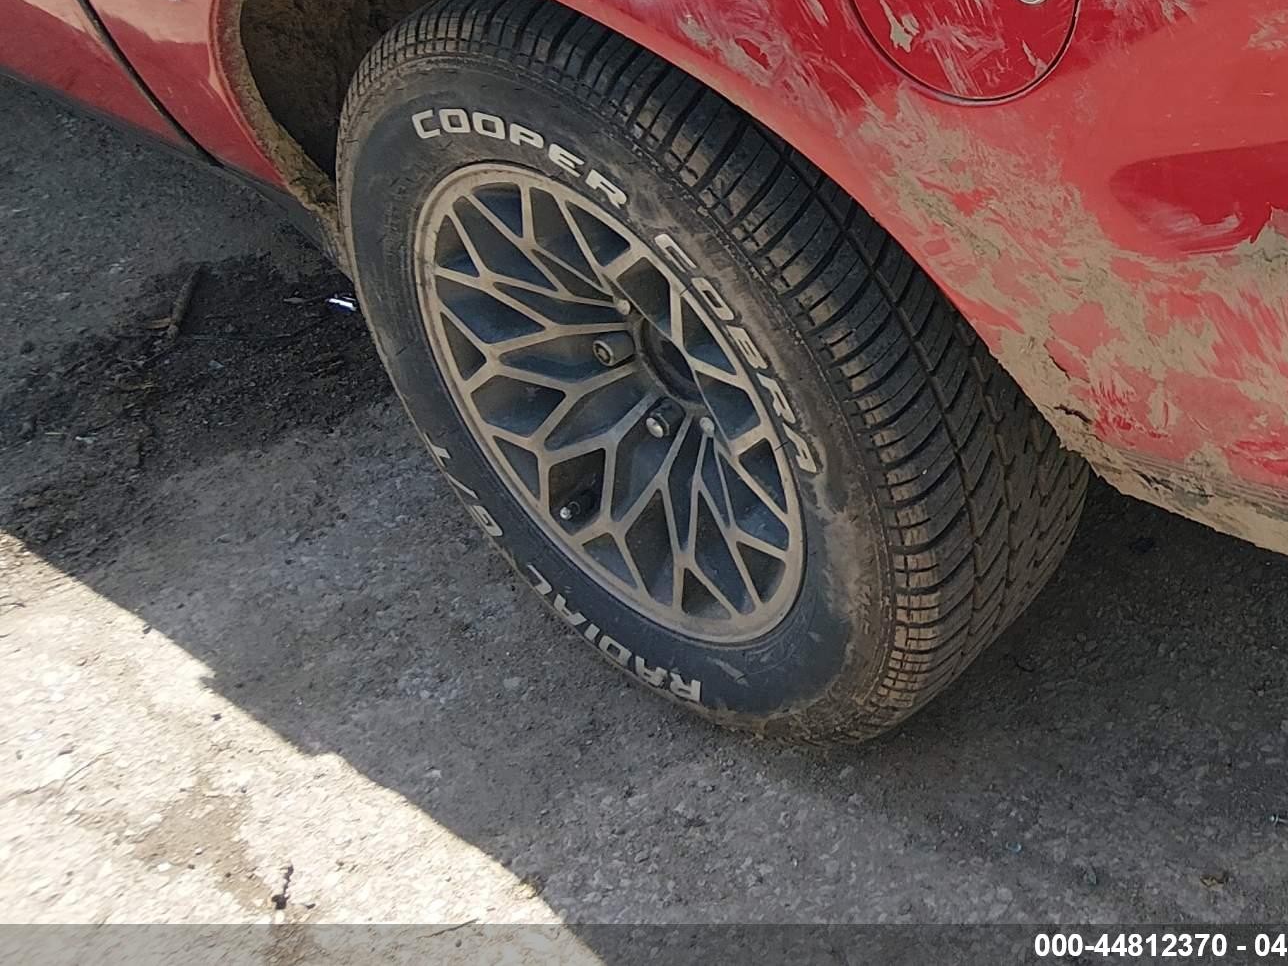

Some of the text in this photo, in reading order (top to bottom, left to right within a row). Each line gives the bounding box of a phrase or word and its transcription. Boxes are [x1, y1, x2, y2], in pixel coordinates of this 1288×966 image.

[411, 108, 817, 474] COOPER COBRA
[527, 563, 701, 703] RADIAL
